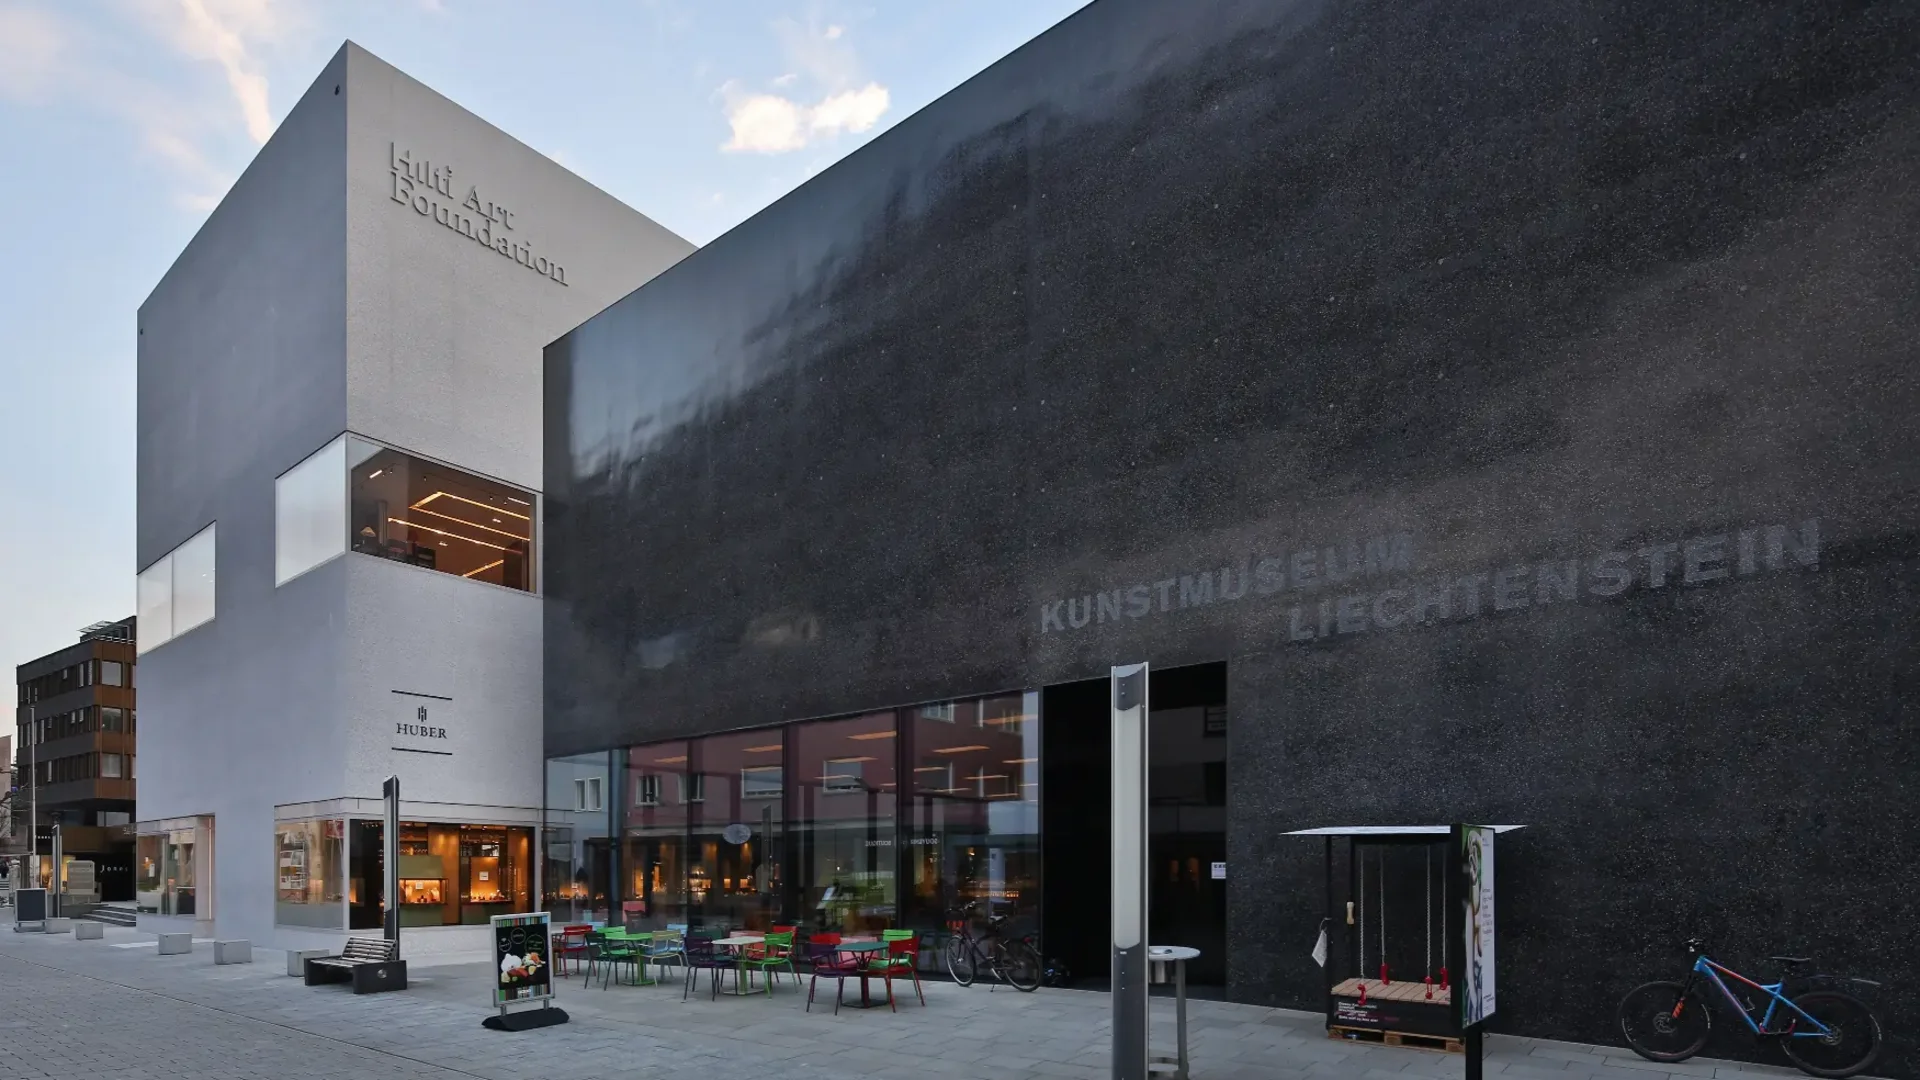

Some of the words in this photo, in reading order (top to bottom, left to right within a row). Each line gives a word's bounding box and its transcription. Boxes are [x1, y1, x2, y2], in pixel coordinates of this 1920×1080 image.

[390, 142, 454, 199] Hilti
[463, 185, 514, 231] Art
[390, 169, 569, 287] Foundation
[1040, 531, 1413, 633] KUNSTMUSEUM
[1288, 517, 1821, 642] LIECHTENSTEIN
[396, 723, 448, 739] HUBER
